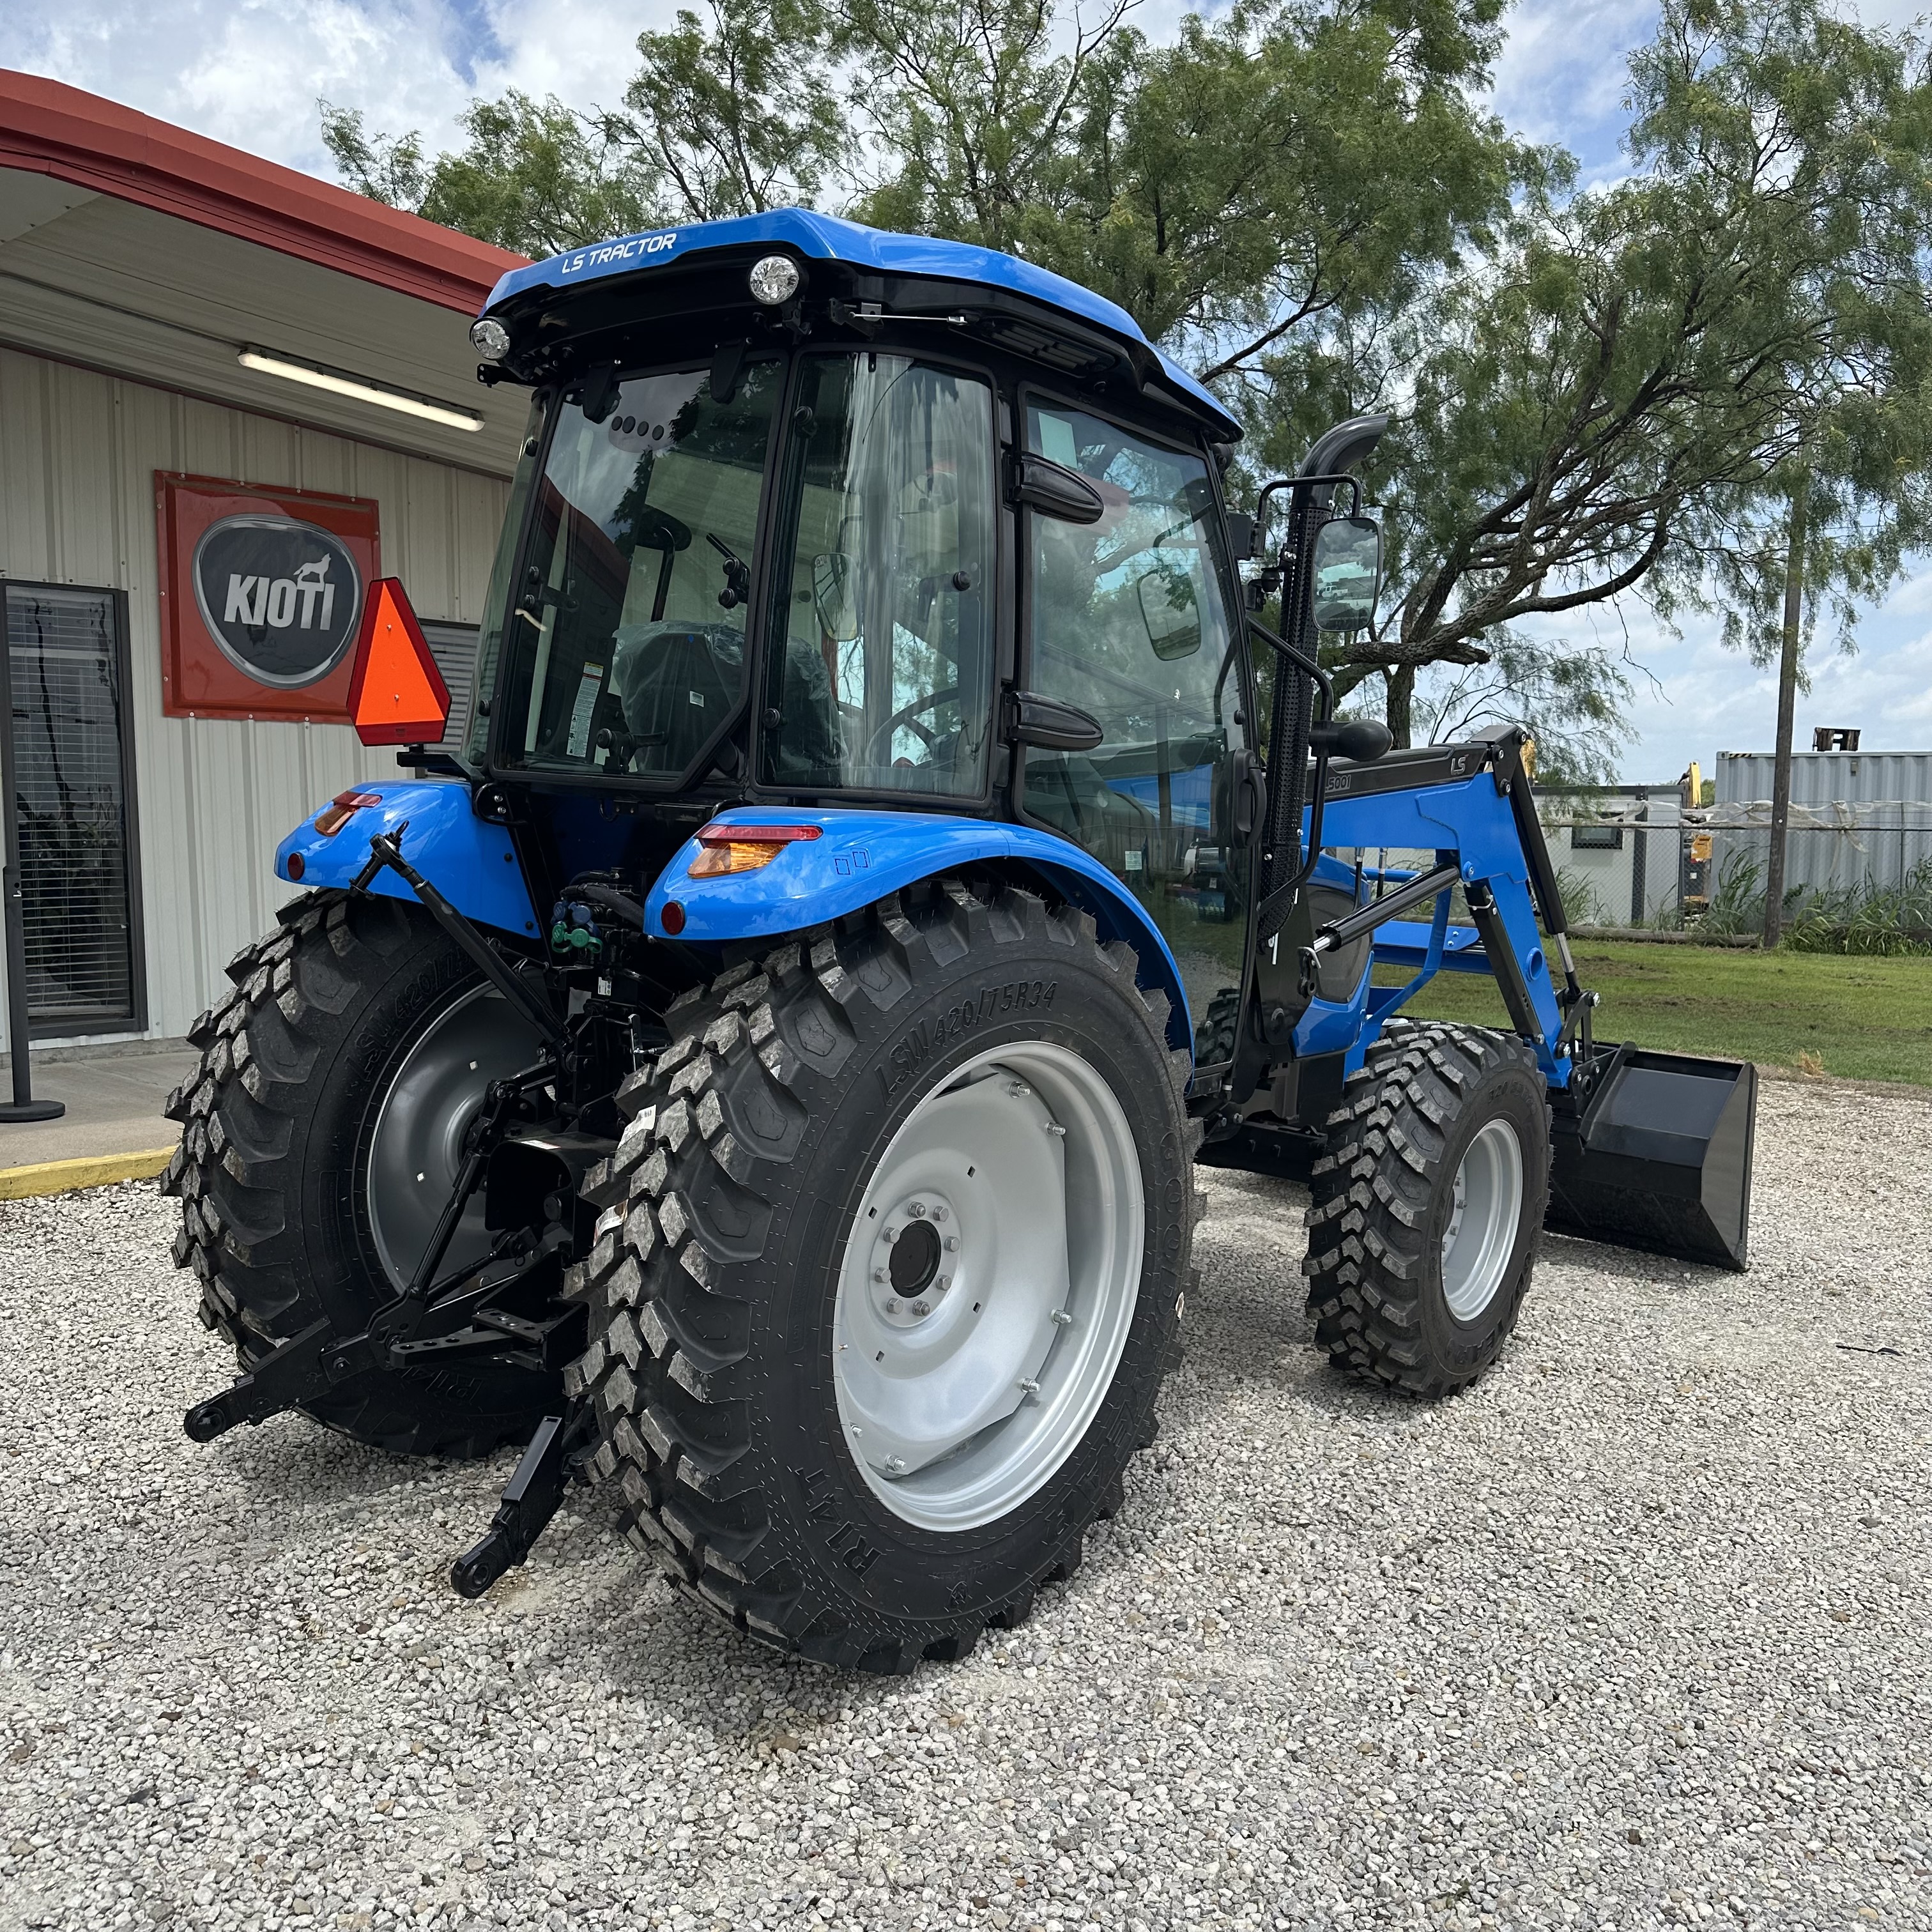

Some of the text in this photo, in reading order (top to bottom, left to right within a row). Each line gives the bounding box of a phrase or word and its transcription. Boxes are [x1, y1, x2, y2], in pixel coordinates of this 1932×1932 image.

[562, 233, 677, 273] LS TRACTOR
[224, 574, 335, 631] KIOTI
[1450, 756, 1467, 776] LS
[934, 980, 1058, 1047] 420/75R34
[794, 1468, 882, 1578] R14T
